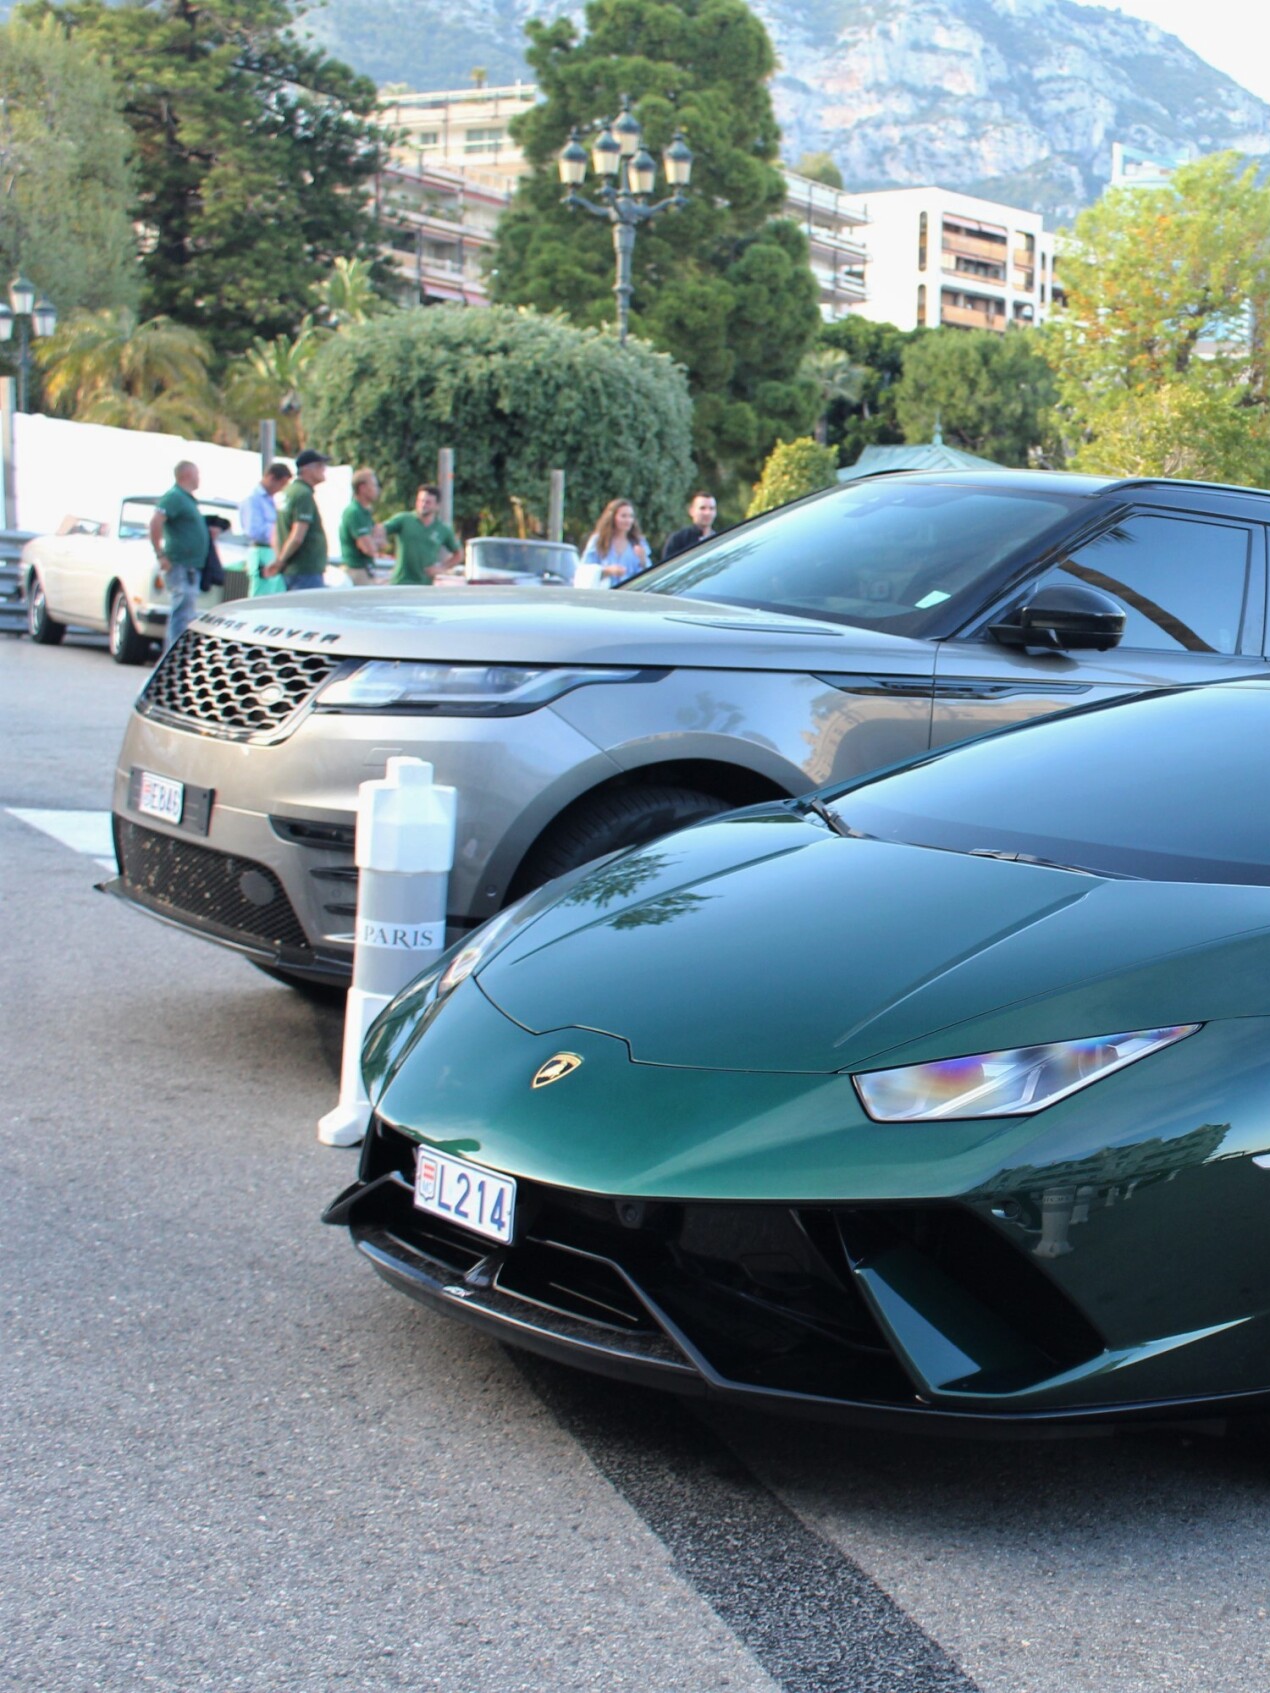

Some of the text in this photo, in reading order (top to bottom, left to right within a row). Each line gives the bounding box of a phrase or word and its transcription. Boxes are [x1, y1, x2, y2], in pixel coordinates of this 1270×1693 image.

[253, 624, 341, 644] ROVER
[364, 925, 433, 950] PARIS
[437, 1164, 505, 1231] L214
